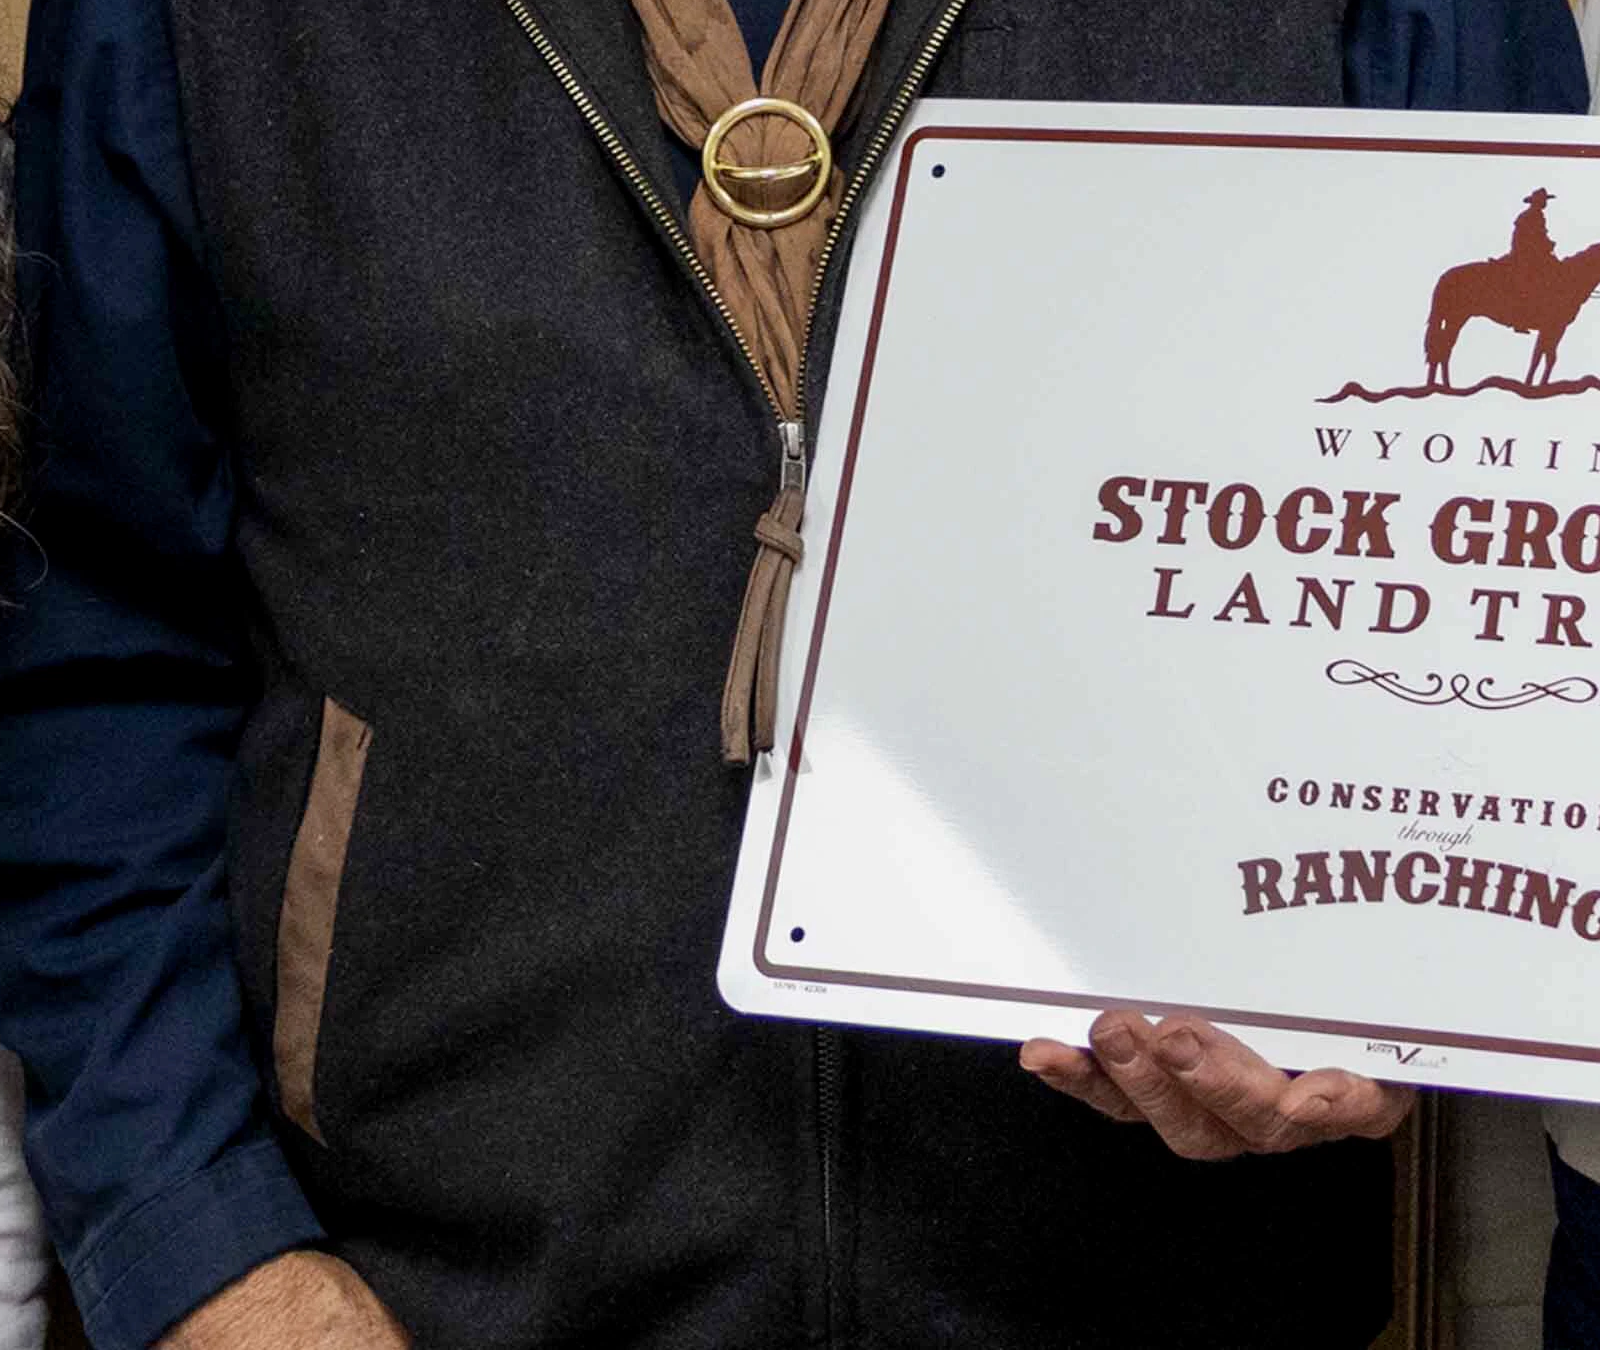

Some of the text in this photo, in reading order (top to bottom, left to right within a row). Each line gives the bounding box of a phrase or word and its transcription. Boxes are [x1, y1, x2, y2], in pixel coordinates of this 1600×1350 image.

[1092, 475, 1402, 559] STOCK
[1145, 566, 1432, 636] LAND
[1396, 819, 1474, 851] through
